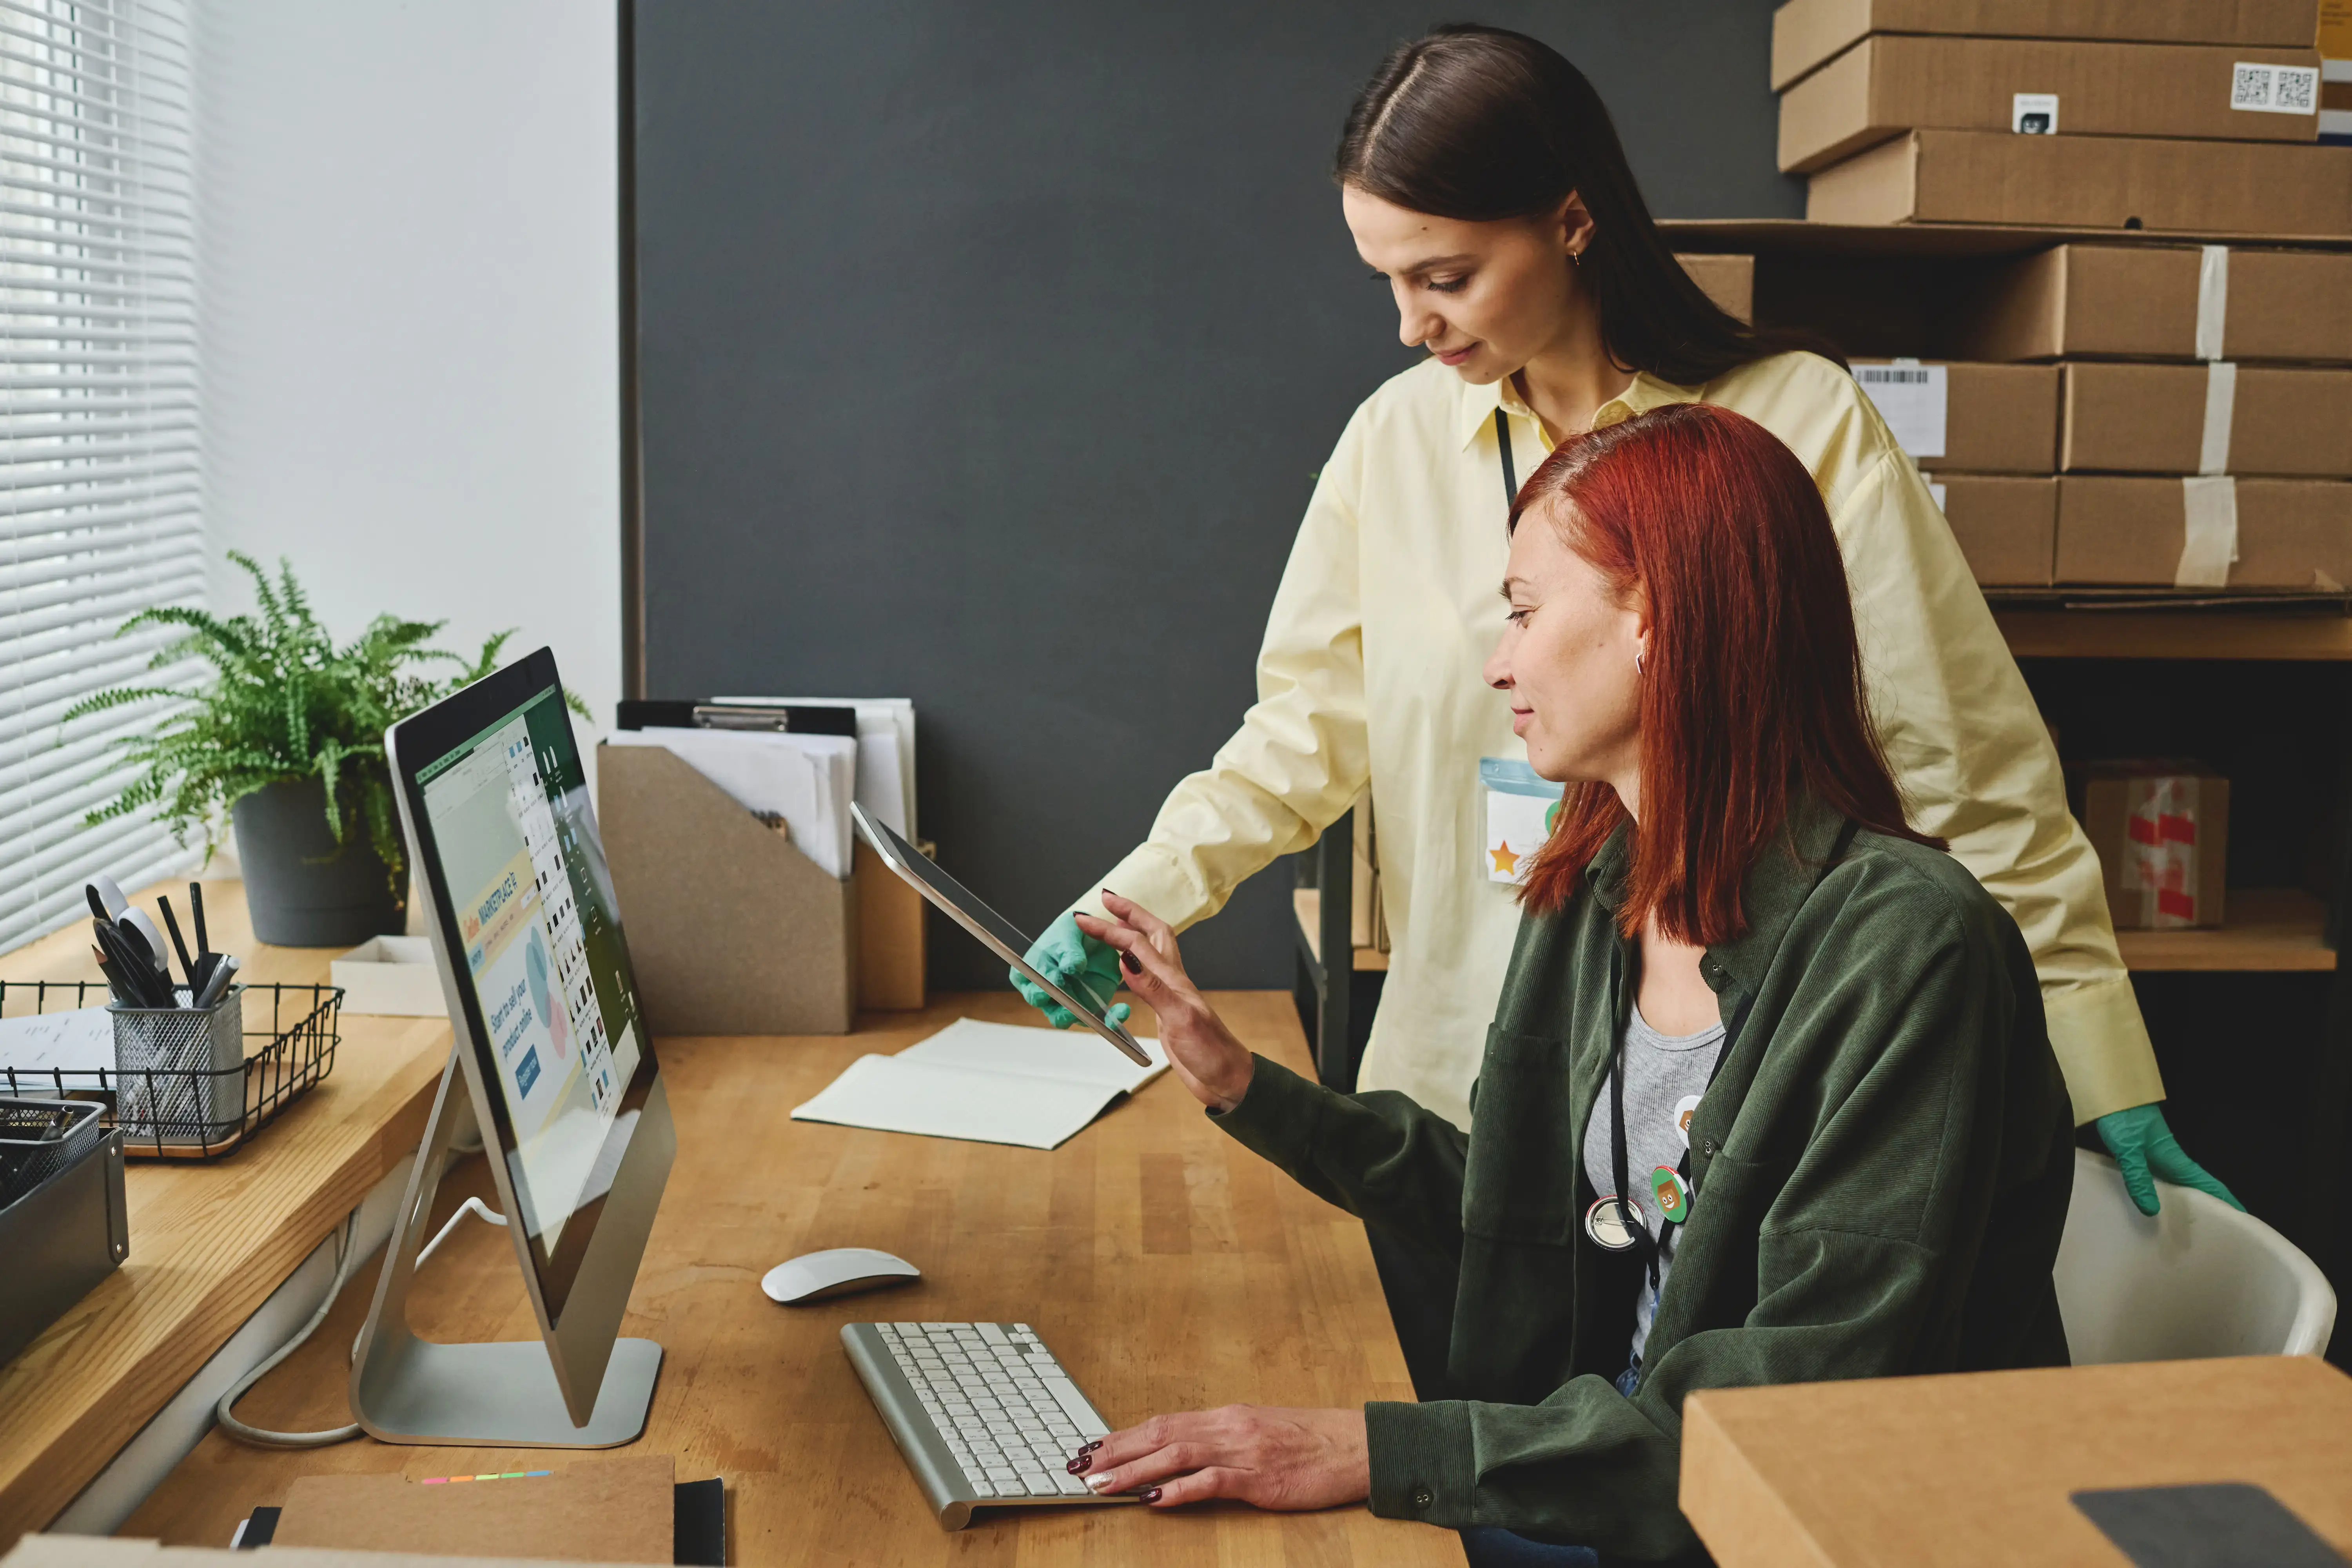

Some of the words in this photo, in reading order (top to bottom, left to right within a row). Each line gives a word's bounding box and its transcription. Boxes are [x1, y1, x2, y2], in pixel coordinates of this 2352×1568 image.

[478, 877, 513, 926] MARKETPLACE
[491, 1007, 505, 1034] Start
[503, 1003, 510, 1018] to
[508, 985, 517, 1011] sell
[515, 978, 526, 1006] your
[502, 1022, 521, 1063] product
[519, 1008, 532, 1034] online
